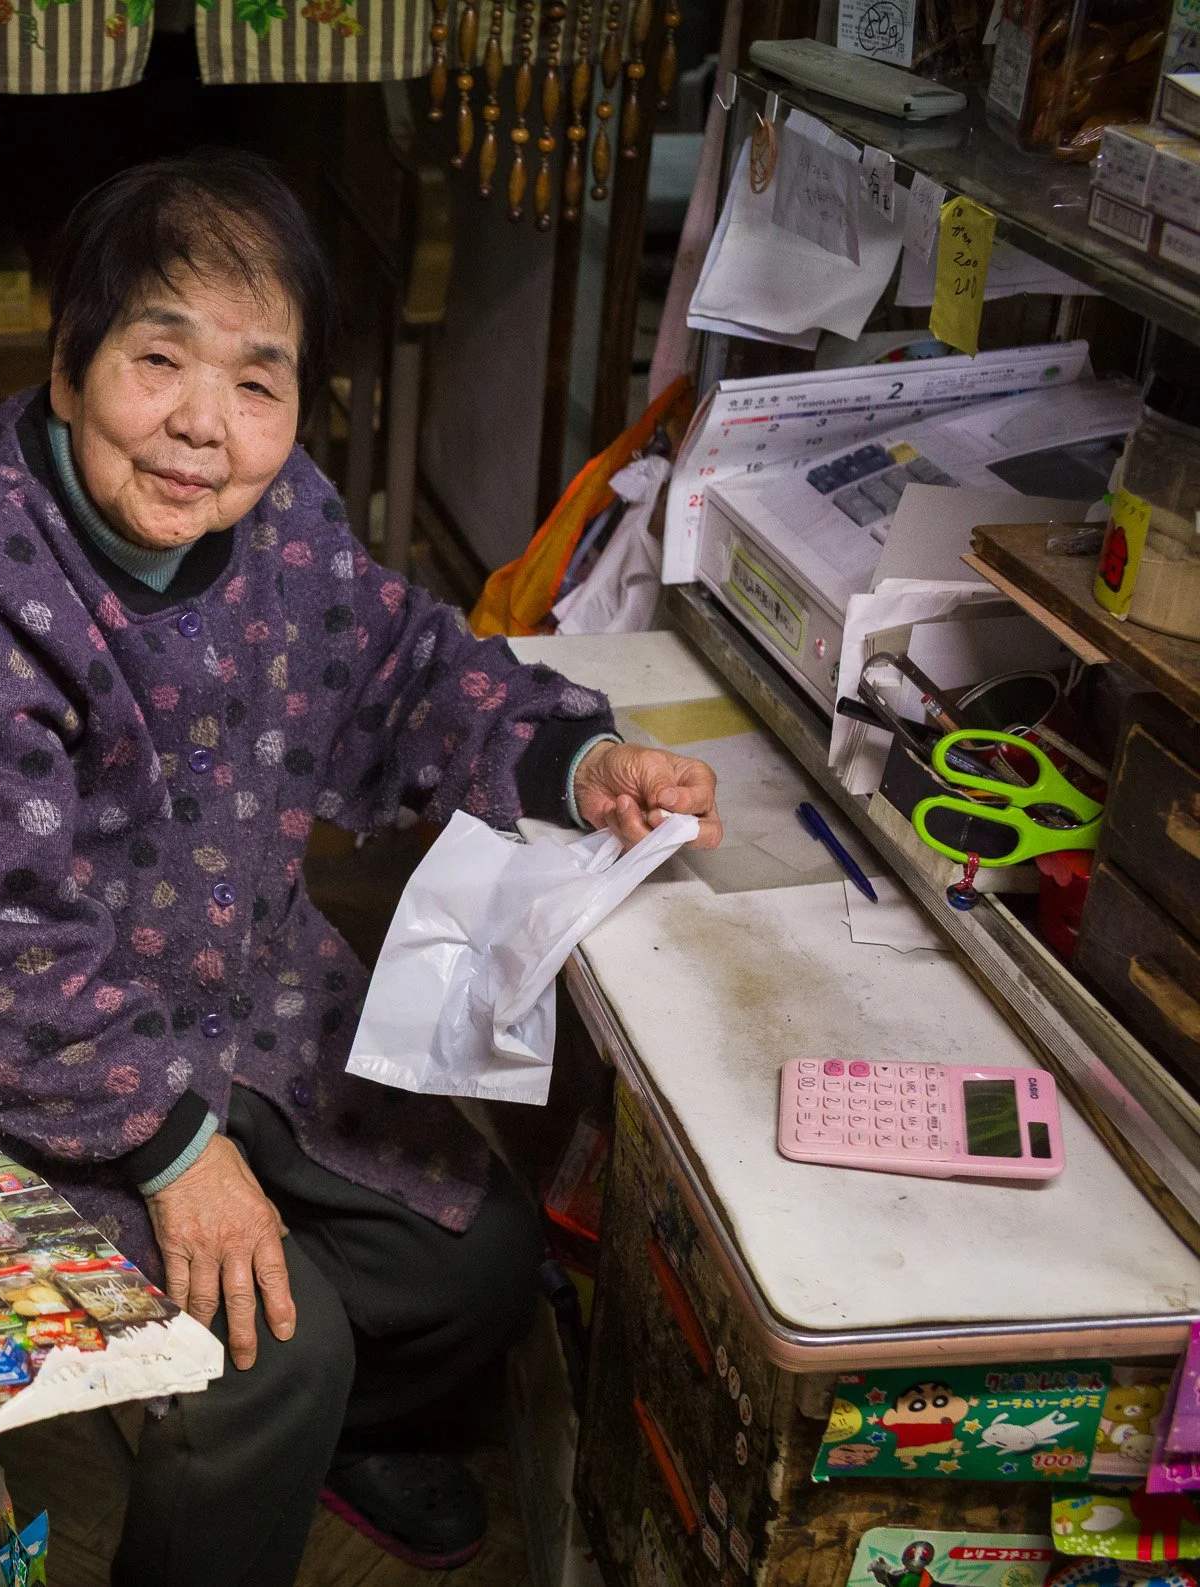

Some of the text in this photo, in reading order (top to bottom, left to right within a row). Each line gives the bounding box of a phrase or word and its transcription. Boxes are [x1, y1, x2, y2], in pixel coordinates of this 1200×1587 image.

[796, 397, 850, 410] FEBRUARY
[887, 382, 904, 400] 2
[723, 429, 730, 438] 1
[767, 423, 780, 433] 2
[816, 418, 828, 428] 3
[698, 466, 717, 476] 15
[746, 461, 764, 474] 16
[853, 1064, 866, 1073] C
[1028, 1077, 1039, 1099] CASIO
[963, 1549, 1043, 1560] レリーフチョコ
